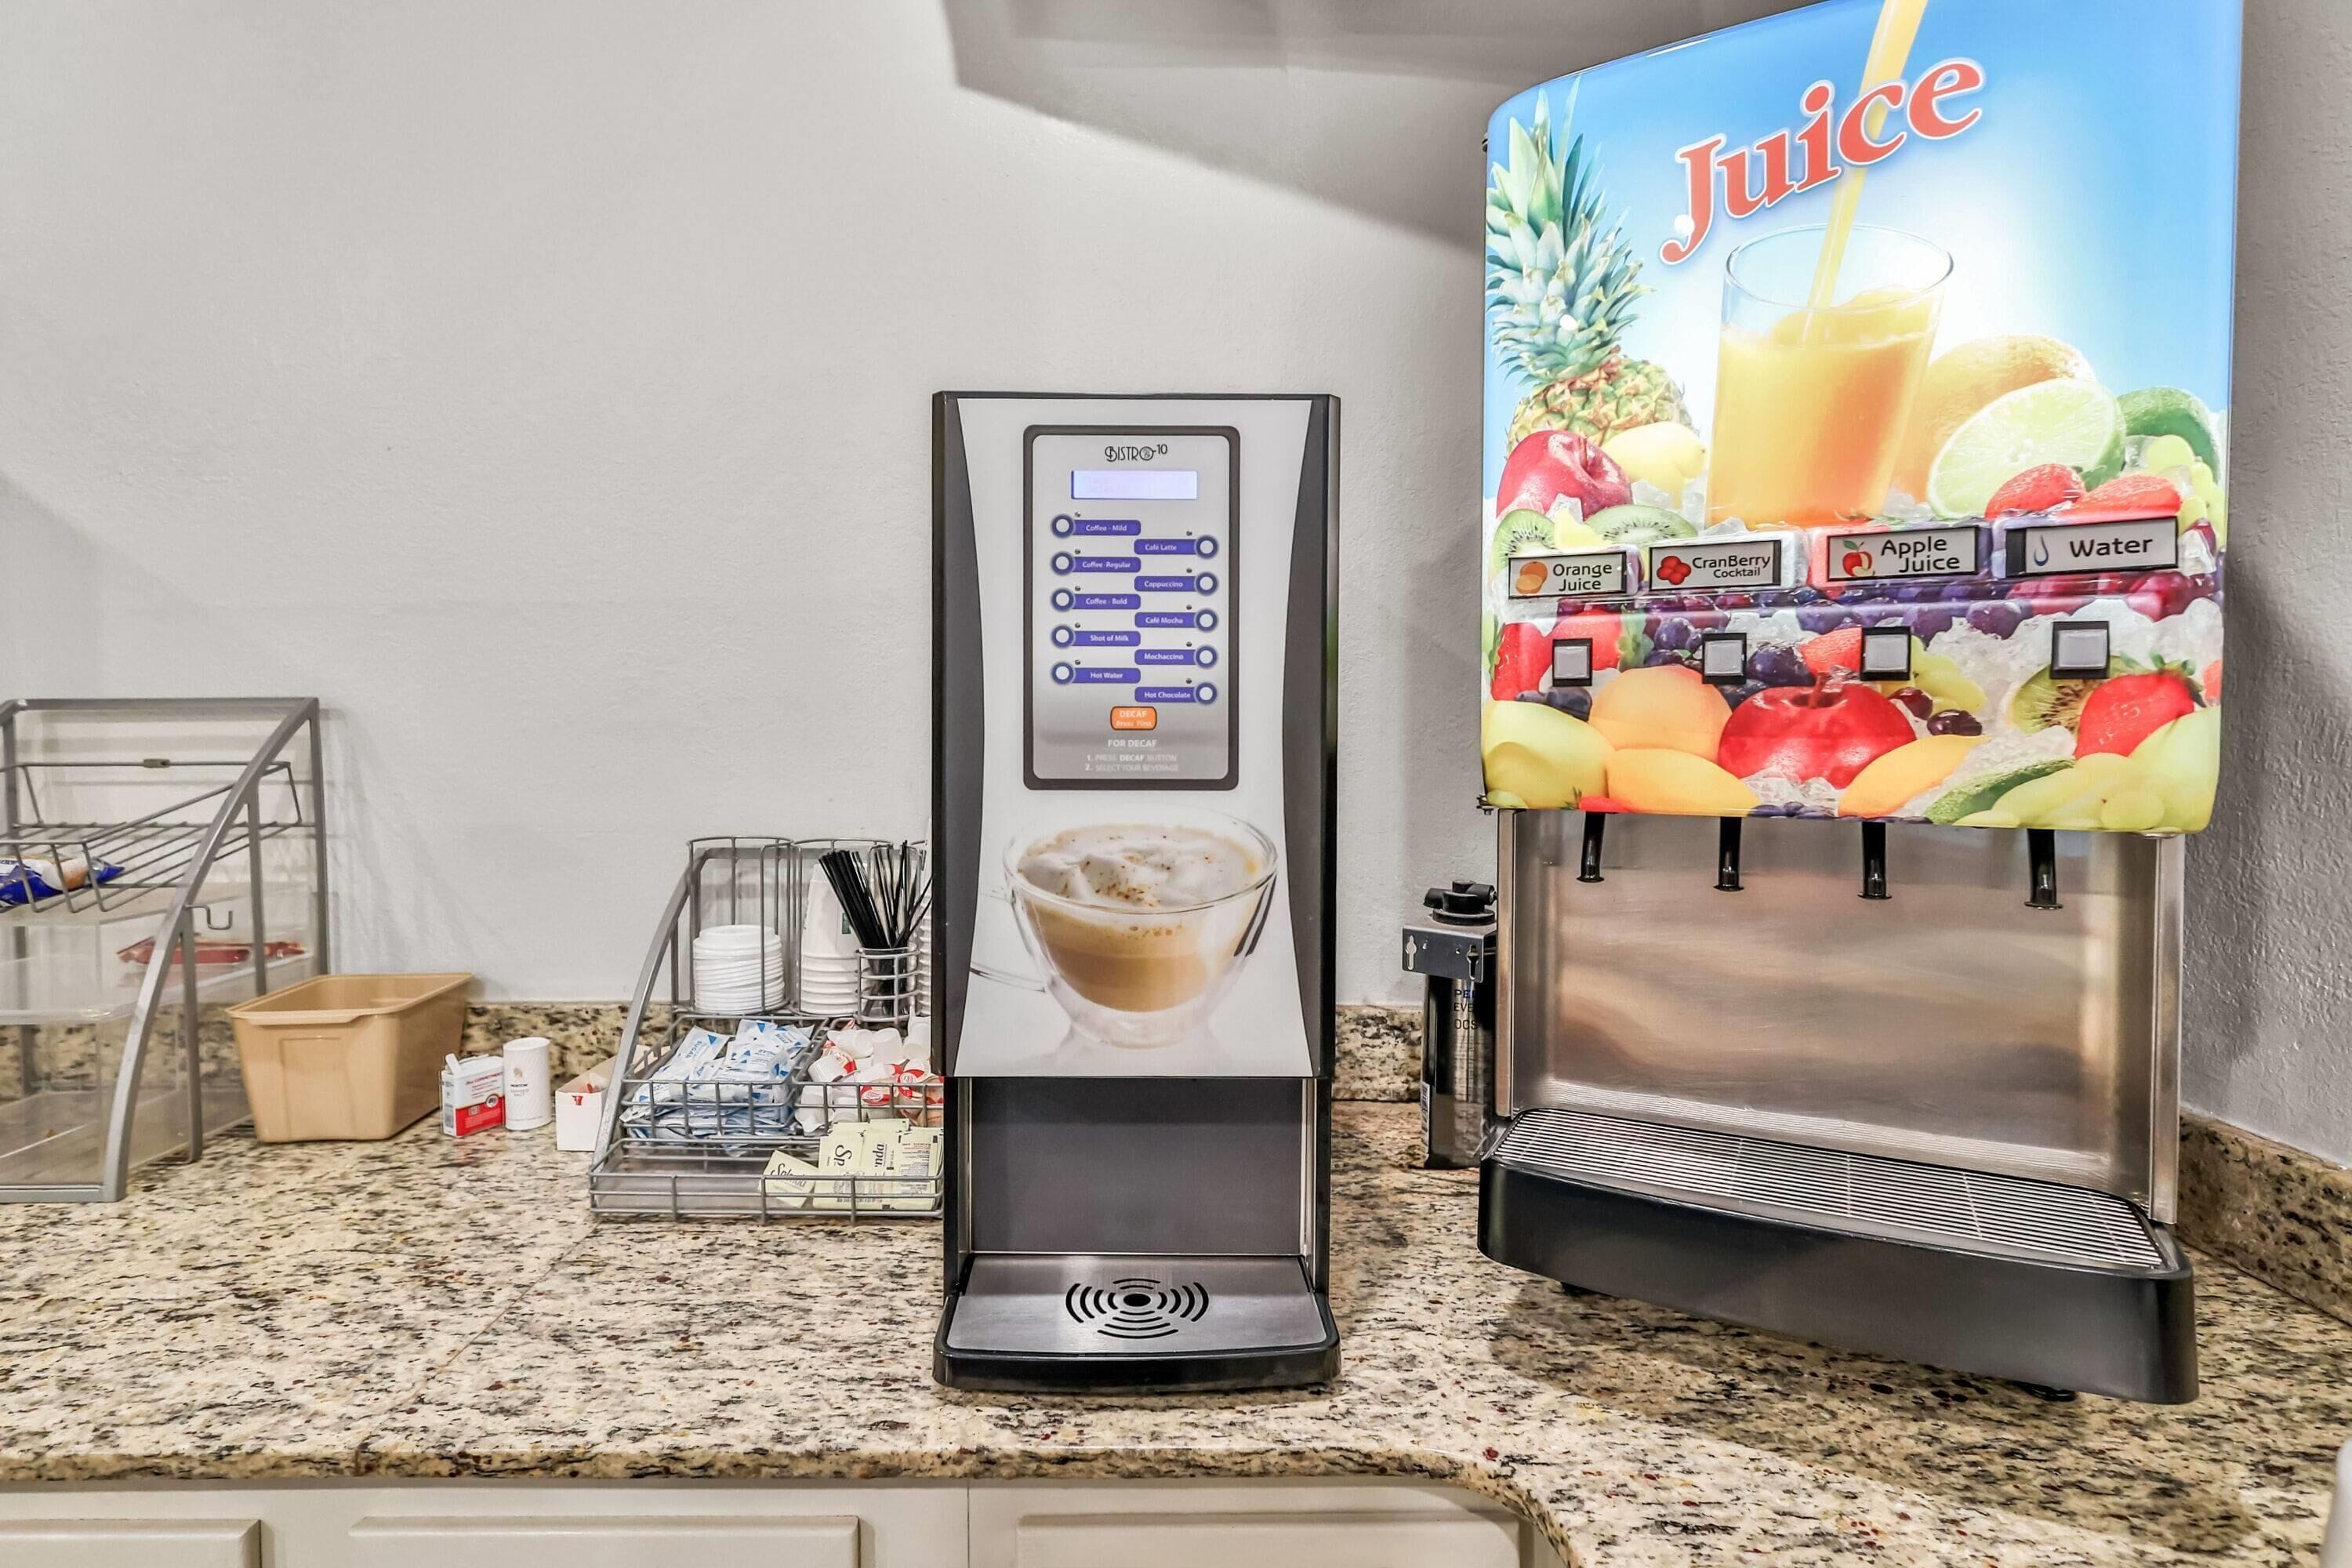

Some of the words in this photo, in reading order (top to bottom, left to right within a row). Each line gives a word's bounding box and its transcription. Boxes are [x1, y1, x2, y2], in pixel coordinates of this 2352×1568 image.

[1659, 58, 1984, 265] Juice
[1104, 445, 1156, 463] BISTRO
[1881, 535, 1947, 559] Apple
[2070, 535, 2154, 557] Water
[1106, 561, 1131, 569] Regular
[1552, 562, 1613, 579] Orange
[1692, 554, 1771, 571] CranBerry
[1898, 554, 1961, 574] Juice
[1713, 566, 1761, 579] Cocktail
[1559, 577, 1602, 593] Juice
[872, 1143, 885, 1167] nda
